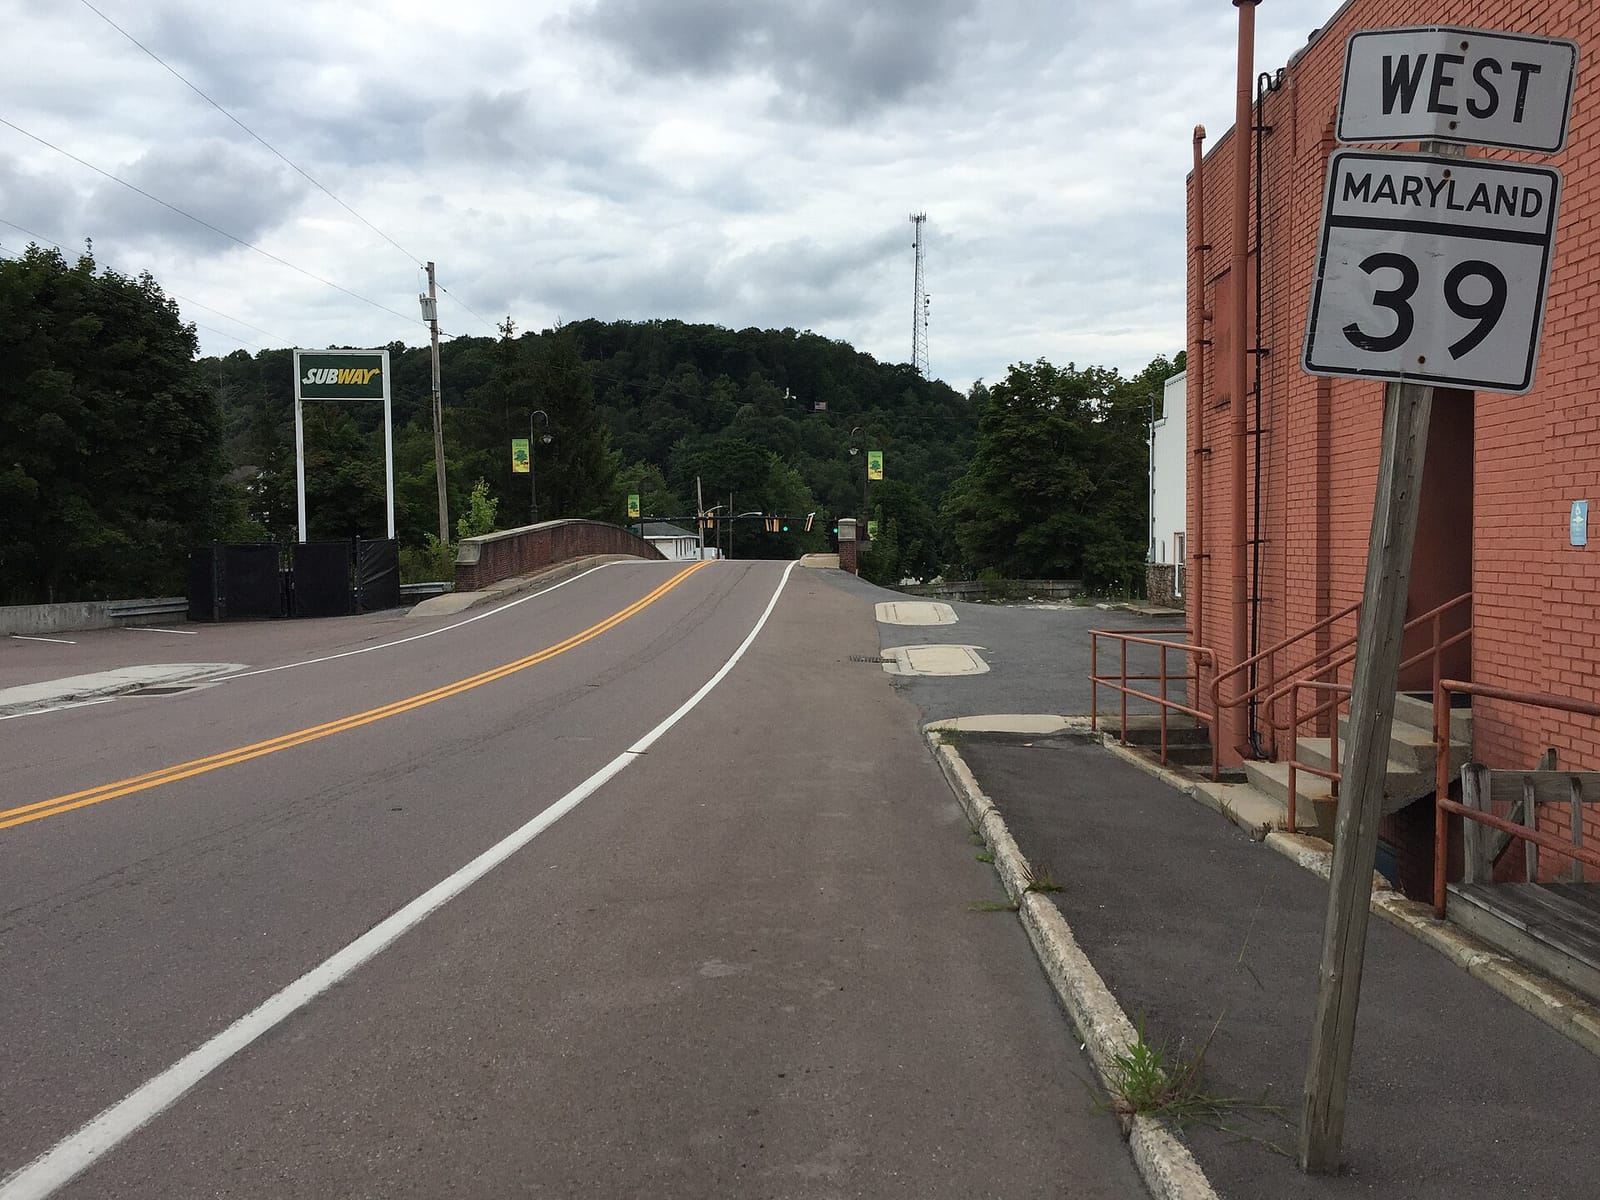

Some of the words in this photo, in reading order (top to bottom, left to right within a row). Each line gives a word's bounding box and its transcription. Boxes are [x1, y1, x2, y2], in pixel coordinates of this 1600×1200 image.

[1381, 53, 1542, 123] WEST
[1342, 171, 1543, 219] MARYLAND
[1341, 251, 1508, 361] 39
[301, 367, 381, 385] SUBWAY
